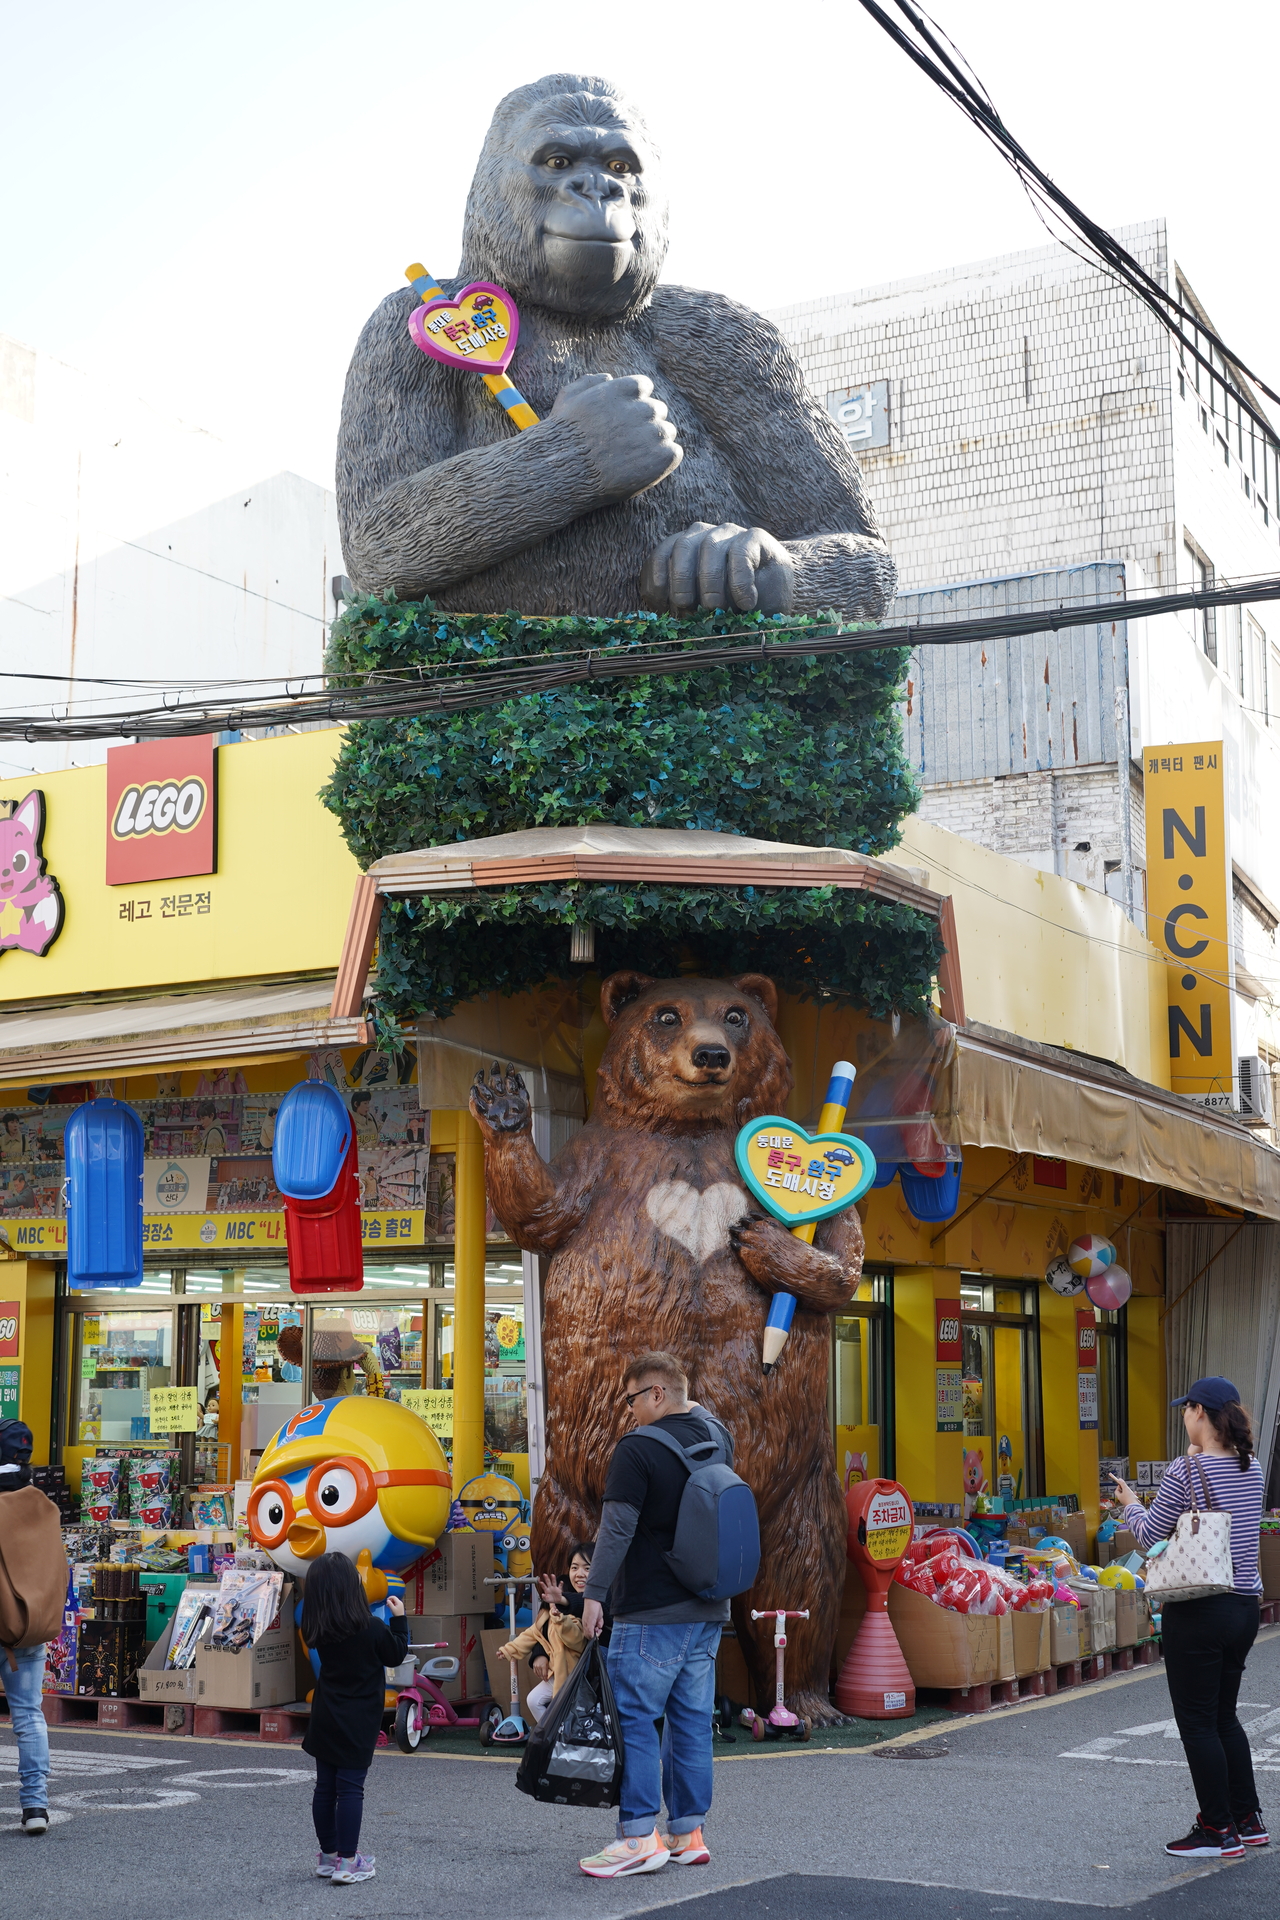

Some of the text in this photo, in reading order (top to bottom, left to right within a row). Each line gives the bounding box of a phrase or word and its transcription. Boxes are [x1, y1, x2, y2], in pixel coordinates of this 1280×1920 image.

[456, 322, 508, 356] 도매시장
[1148, 754, 1217, 774] 캐릭터 팬시
[115, 780, 204, 835] LEGO
[119, 891, 212, 922] 레고 전문점
[757, 1135, 794, 1149] 동대문
[165, 1174, 174, 1183] 나
[807, 1159, 842, 1182] 완구
[764, 1168, 836, 1200] 도매시장
[17, 1226, 45, 1245] MBC
[225, 1221, 256, 1240] MBC
[385, 1217, 412, 1239] 출연
[939, 1319, 960, 1341] LEGO
[1079, 1328, 1096, 1349] LEGO
[872, 1506, 906, 1525] 주차금지
[102, 1704, 119, 1712] KPP
